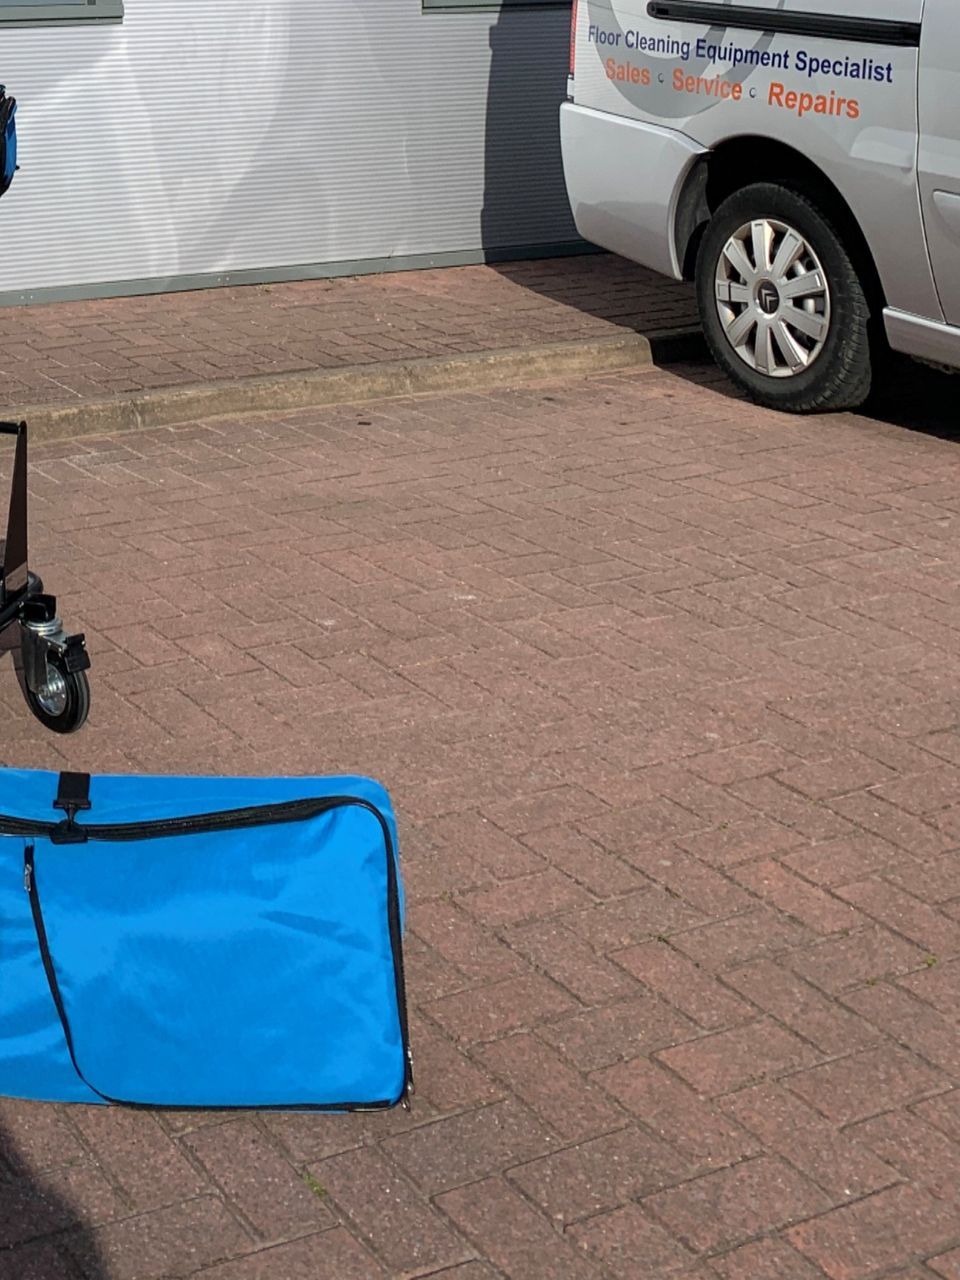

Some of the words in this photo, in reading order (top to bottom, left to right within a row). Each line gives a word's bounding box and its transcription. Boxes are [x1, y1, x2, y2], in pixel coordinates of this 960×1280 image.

[588, 25, 622, 47] Floor
[624, 30, 690, 60] Cleaning
[696, 39, 789, 69] Equipment
[795, 51, 893, 83] Specialist
[605, 58, 651, 85] Sales
[672, 68, 742, 100] Service
[768, 82, 860, 119] Repairs
